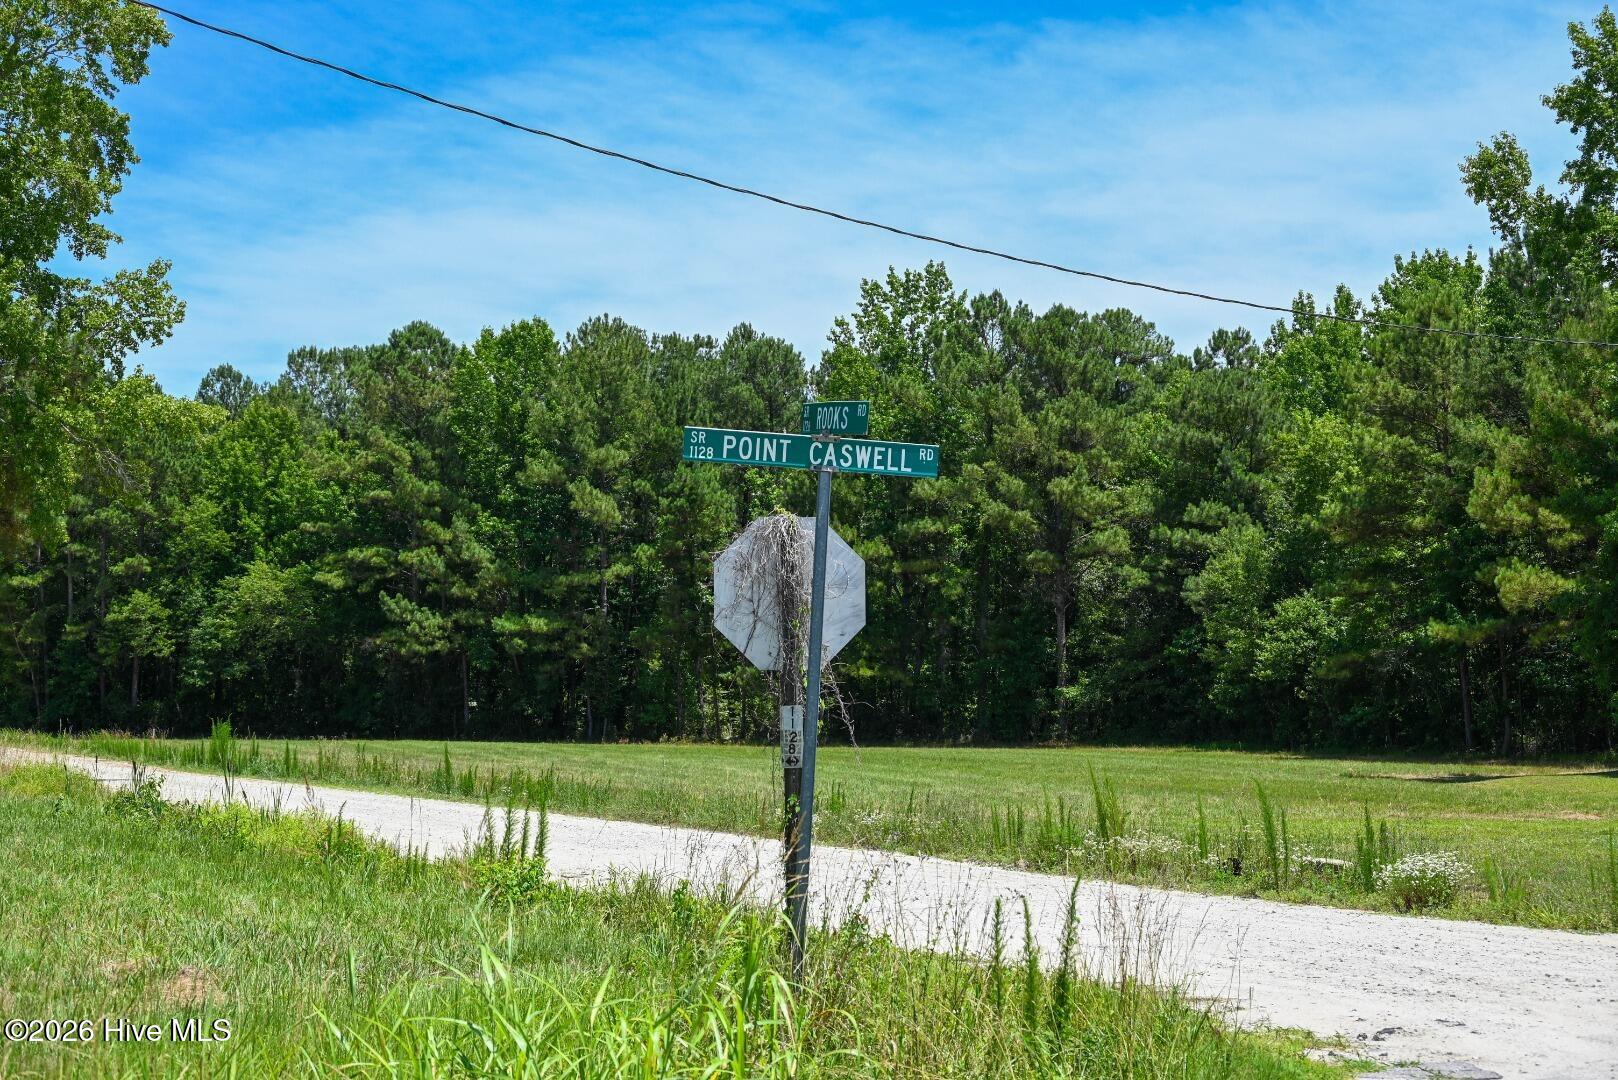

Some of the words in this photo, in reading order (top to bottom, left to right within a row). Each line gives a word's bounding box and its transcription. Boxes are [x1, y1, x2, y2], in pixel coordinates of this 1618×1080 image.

[857, 404, 867, 417] RD
[816, 406, 849, 430] ROOKS
[690, 430, 706, 444] SR
[689, 445, 714, 460] 1128
[722, 435, 792, 463] POINT
[809, 441, 912, 472] CASWELL
[919, 448, 934, 461] RD
